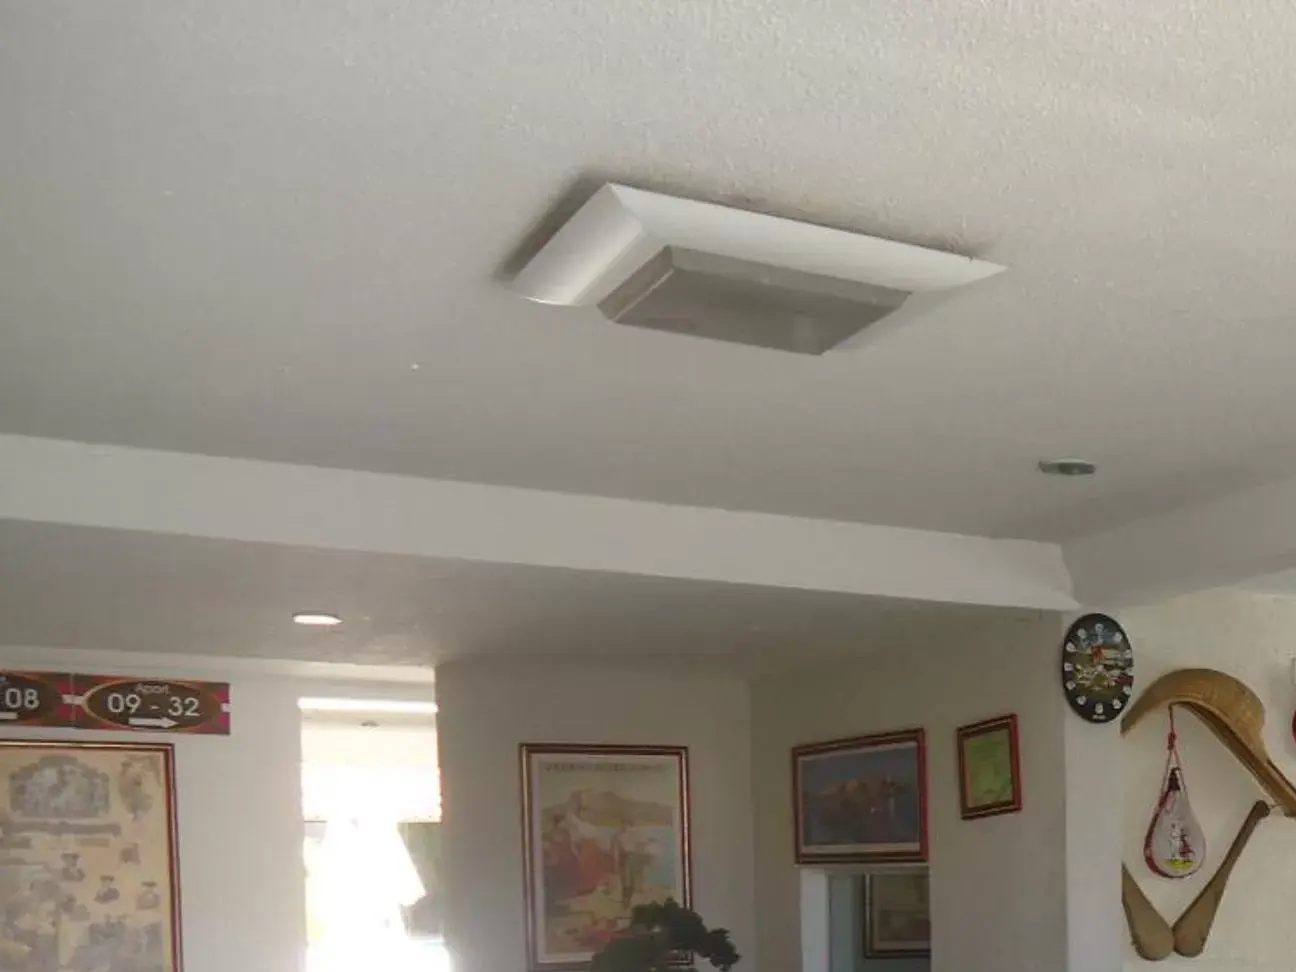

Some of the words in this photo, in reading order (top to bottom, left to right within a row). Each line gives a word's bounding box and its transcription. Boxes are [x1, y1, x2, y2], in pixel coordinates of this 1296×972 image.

[5, 688, 40, 709] 08
[107, 693, 141, 713] 09
[168, 697, 200, 716] 32
